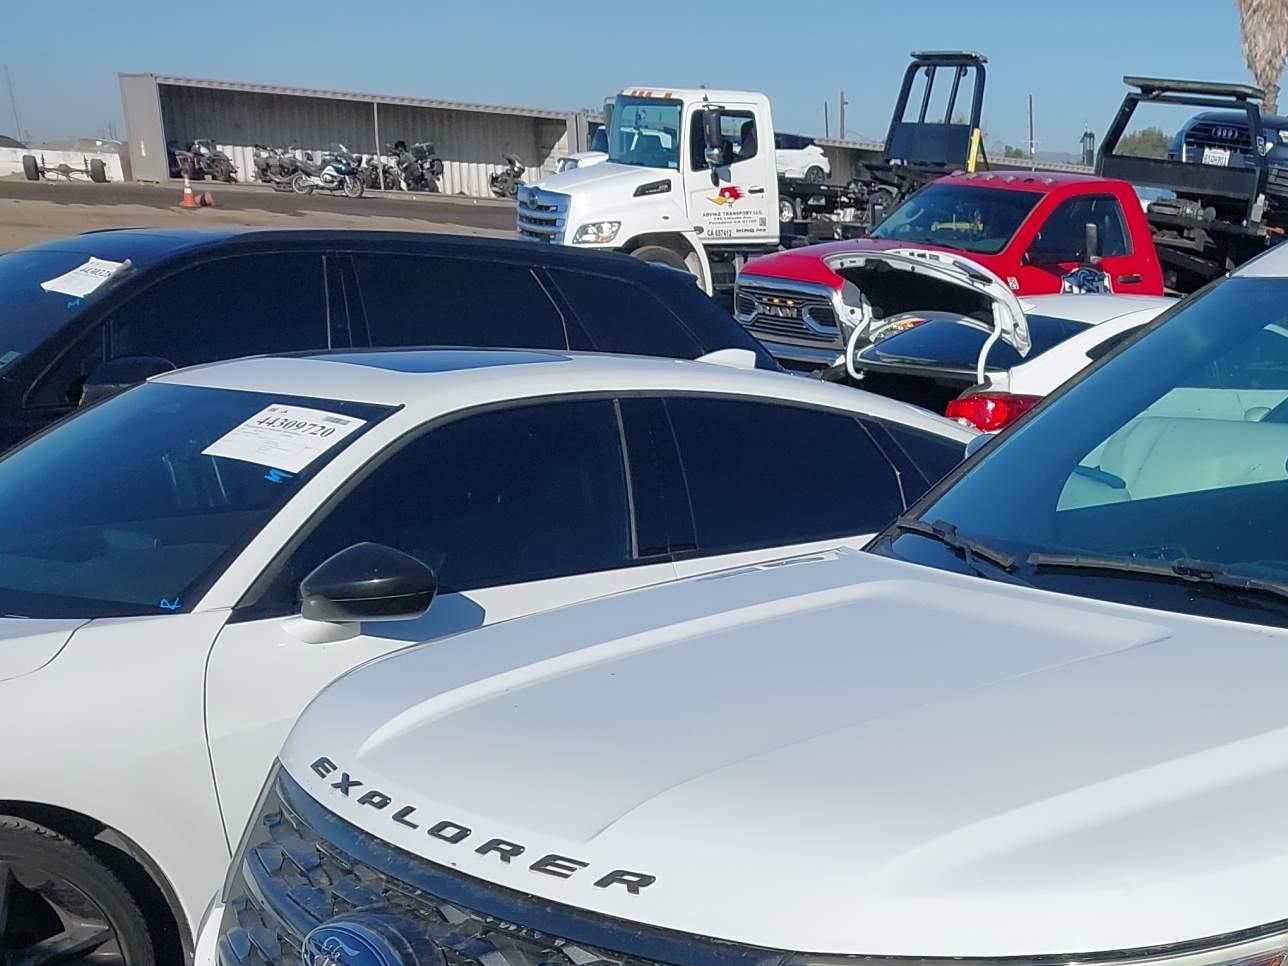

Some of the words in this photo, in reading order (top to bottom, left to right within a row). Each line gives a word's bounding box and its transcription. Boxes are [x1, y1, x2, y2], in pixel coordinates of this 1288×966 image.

[757, 304, 798, 318] RAM
[257, 416, 336, 438] 44309720
[310, 756, 656, 895] EXPLORER
